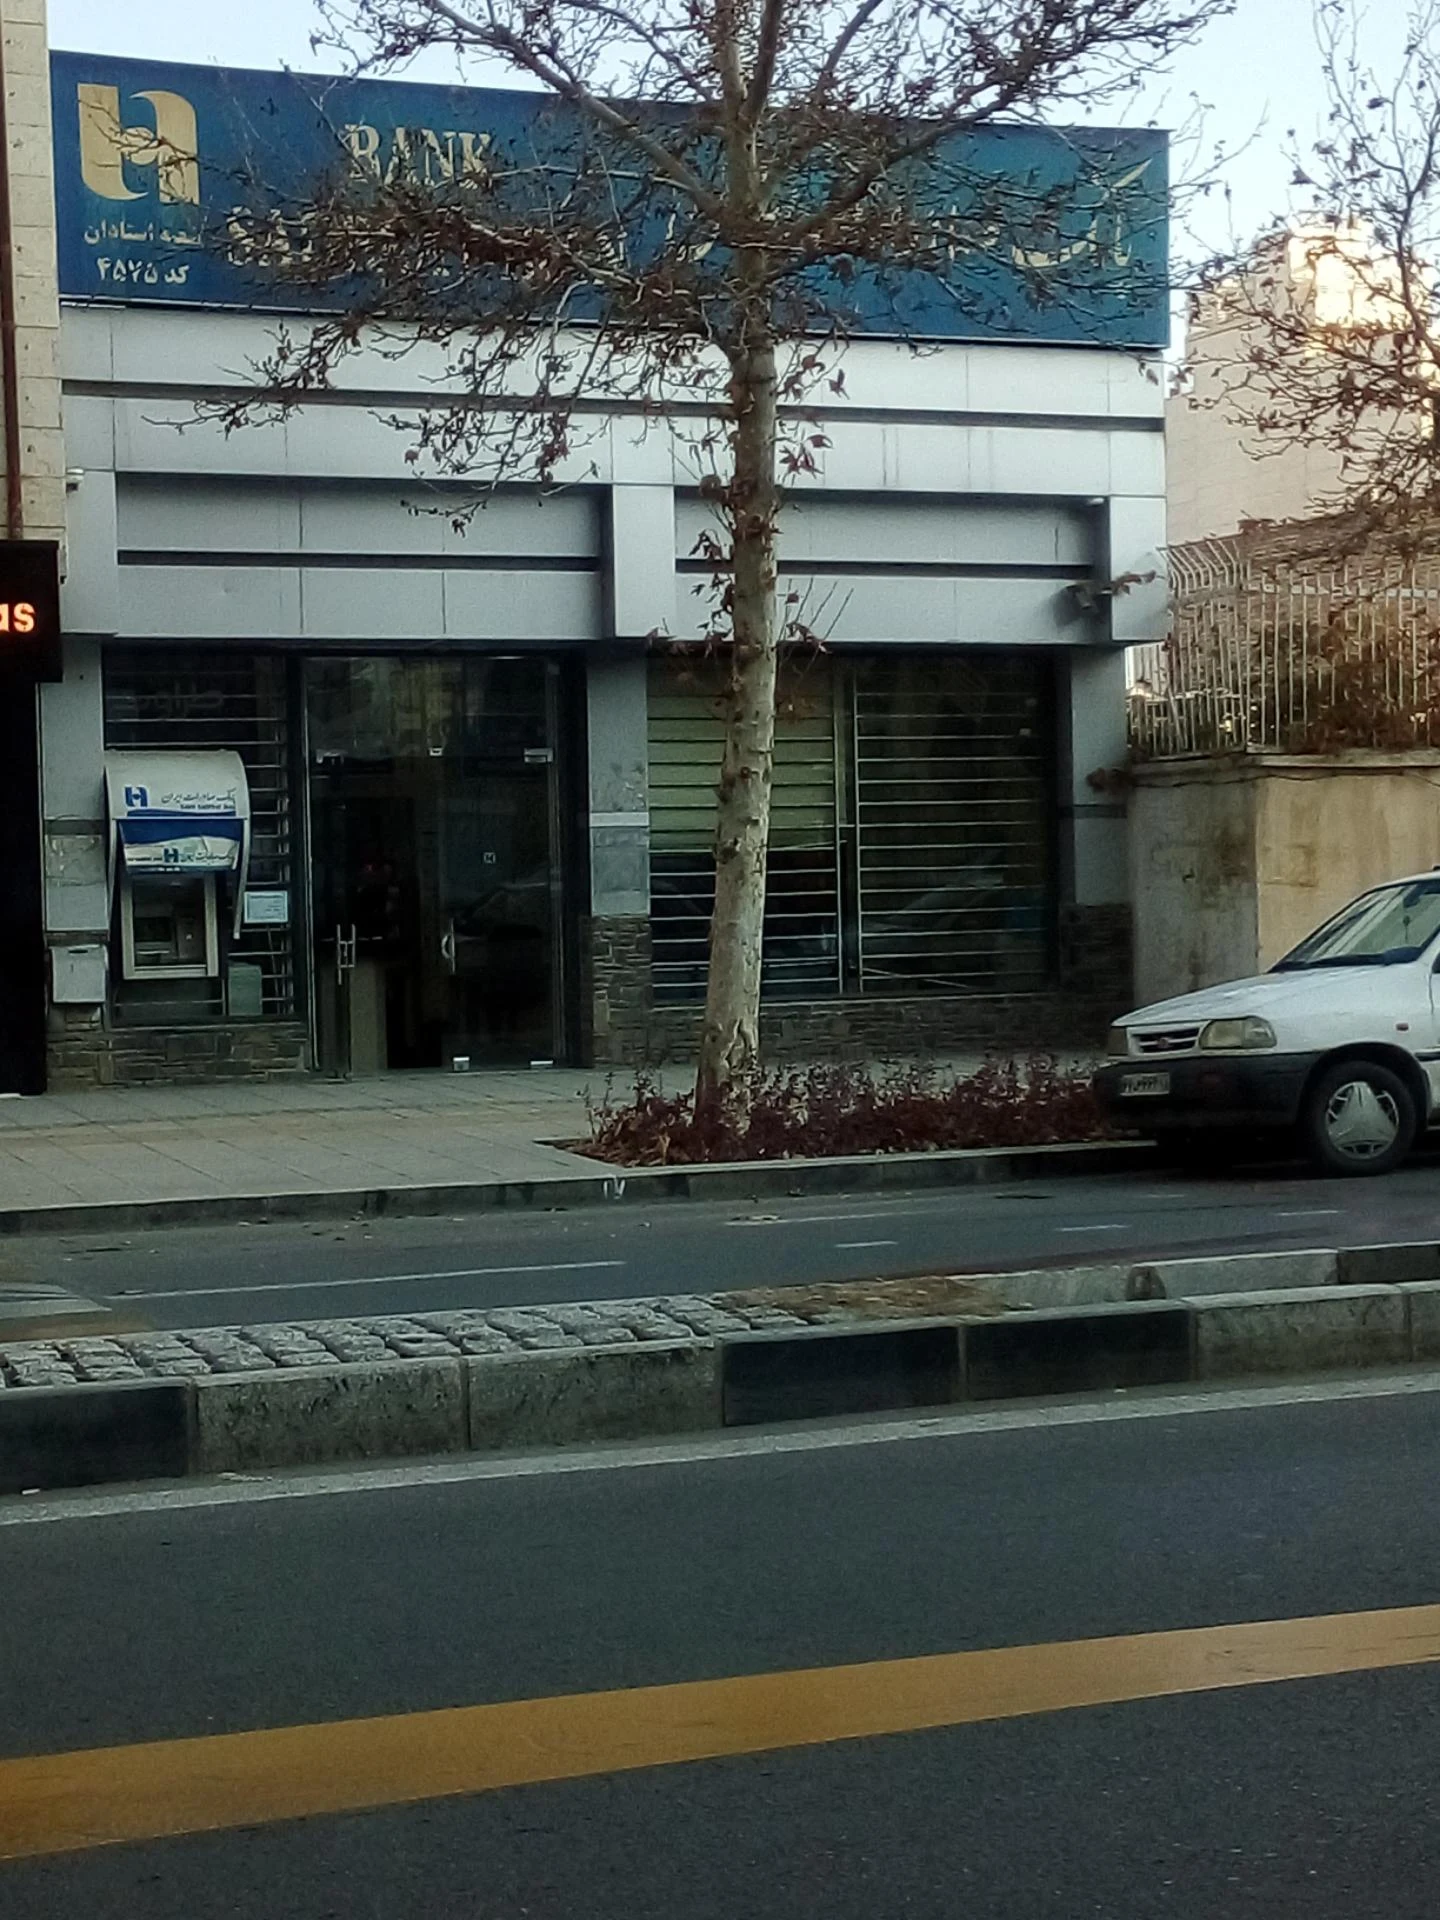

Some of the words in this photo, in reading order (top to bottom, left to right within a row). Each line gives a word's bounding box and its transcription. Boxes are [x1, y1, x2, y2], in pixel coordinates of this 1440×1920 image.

[345, 124, 491, 190] BANK
[96, 256, 159, 284] ۴۵۷۵
[164, 264, 191, 284] کد
